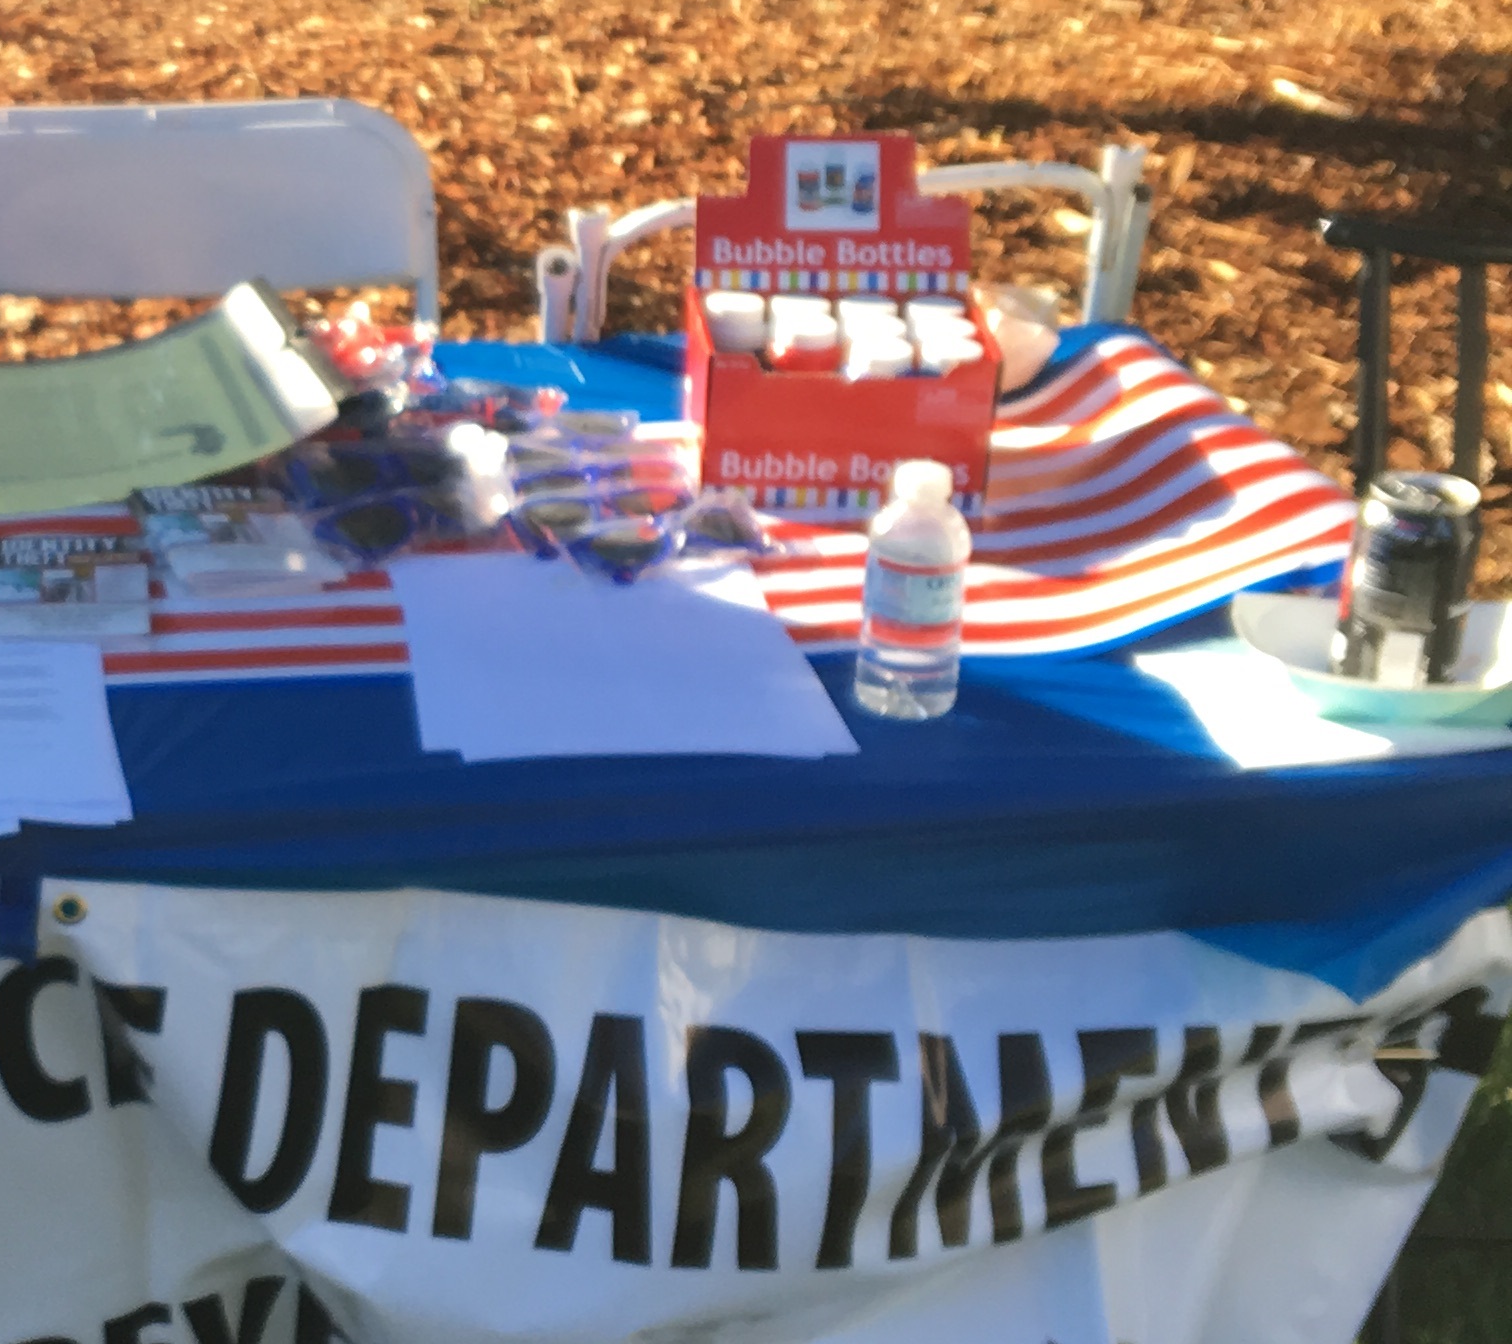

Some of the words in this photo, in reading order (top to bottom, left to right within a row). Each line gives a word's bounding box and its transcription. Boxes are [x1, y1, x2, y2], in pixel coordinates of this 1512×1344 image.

[712, 237, 826, 267] Bubble
[838, 238, 954, 268] Bottles
[720, 450, 838, 480] Bubble
